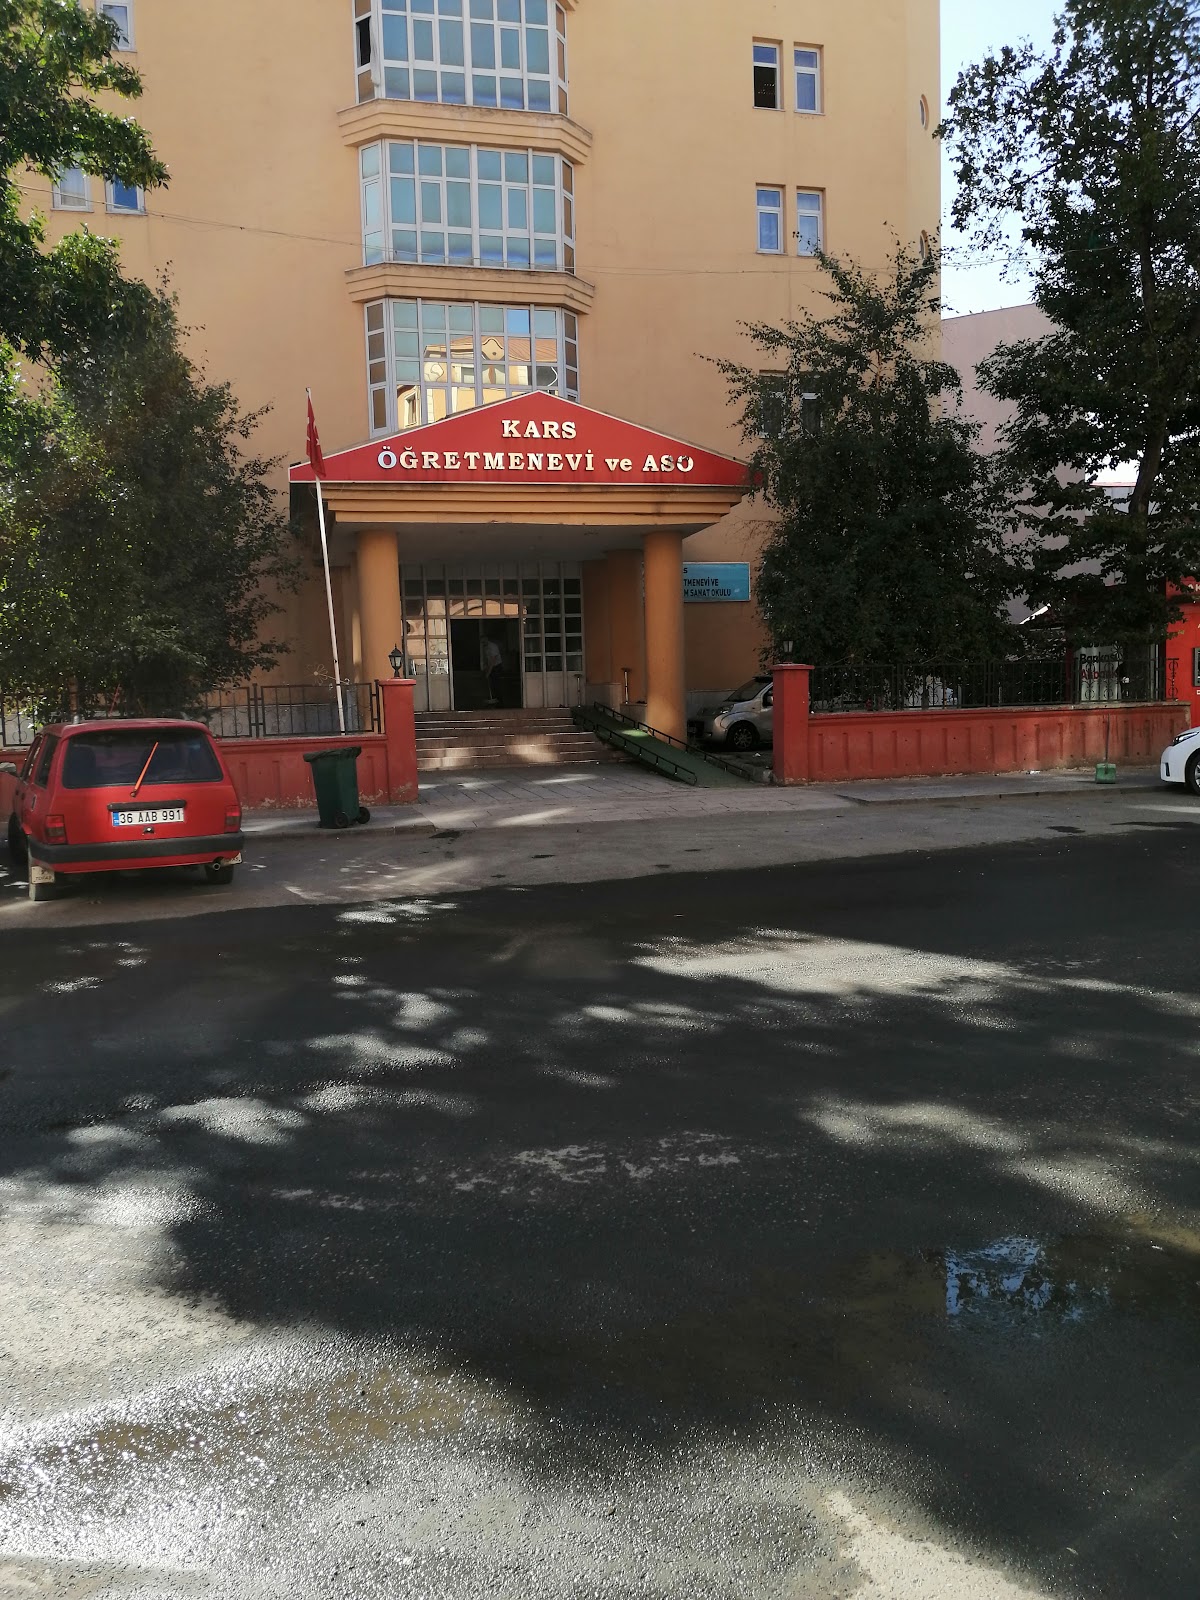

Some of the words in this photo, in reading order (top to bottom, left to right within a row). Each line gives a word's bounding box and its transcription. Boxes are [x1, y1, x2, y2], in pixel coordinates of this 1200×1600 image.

[501, 420, 577, 439] KARS
[377, 445, 594, 471] ÖĞRETMENEVİ
[605, 458, 632, 472] ve
[684, 577, 710, 587] TMENEVİ
[711, 579, 719, 587] VE
[690, 589, 710, 597] SANAT
[712, 589, 731, 597] OKULU
[119, 813, 133, 824] 36
[138, 811, 158, 823] AAB
[161, 809, 181, 821] 991
